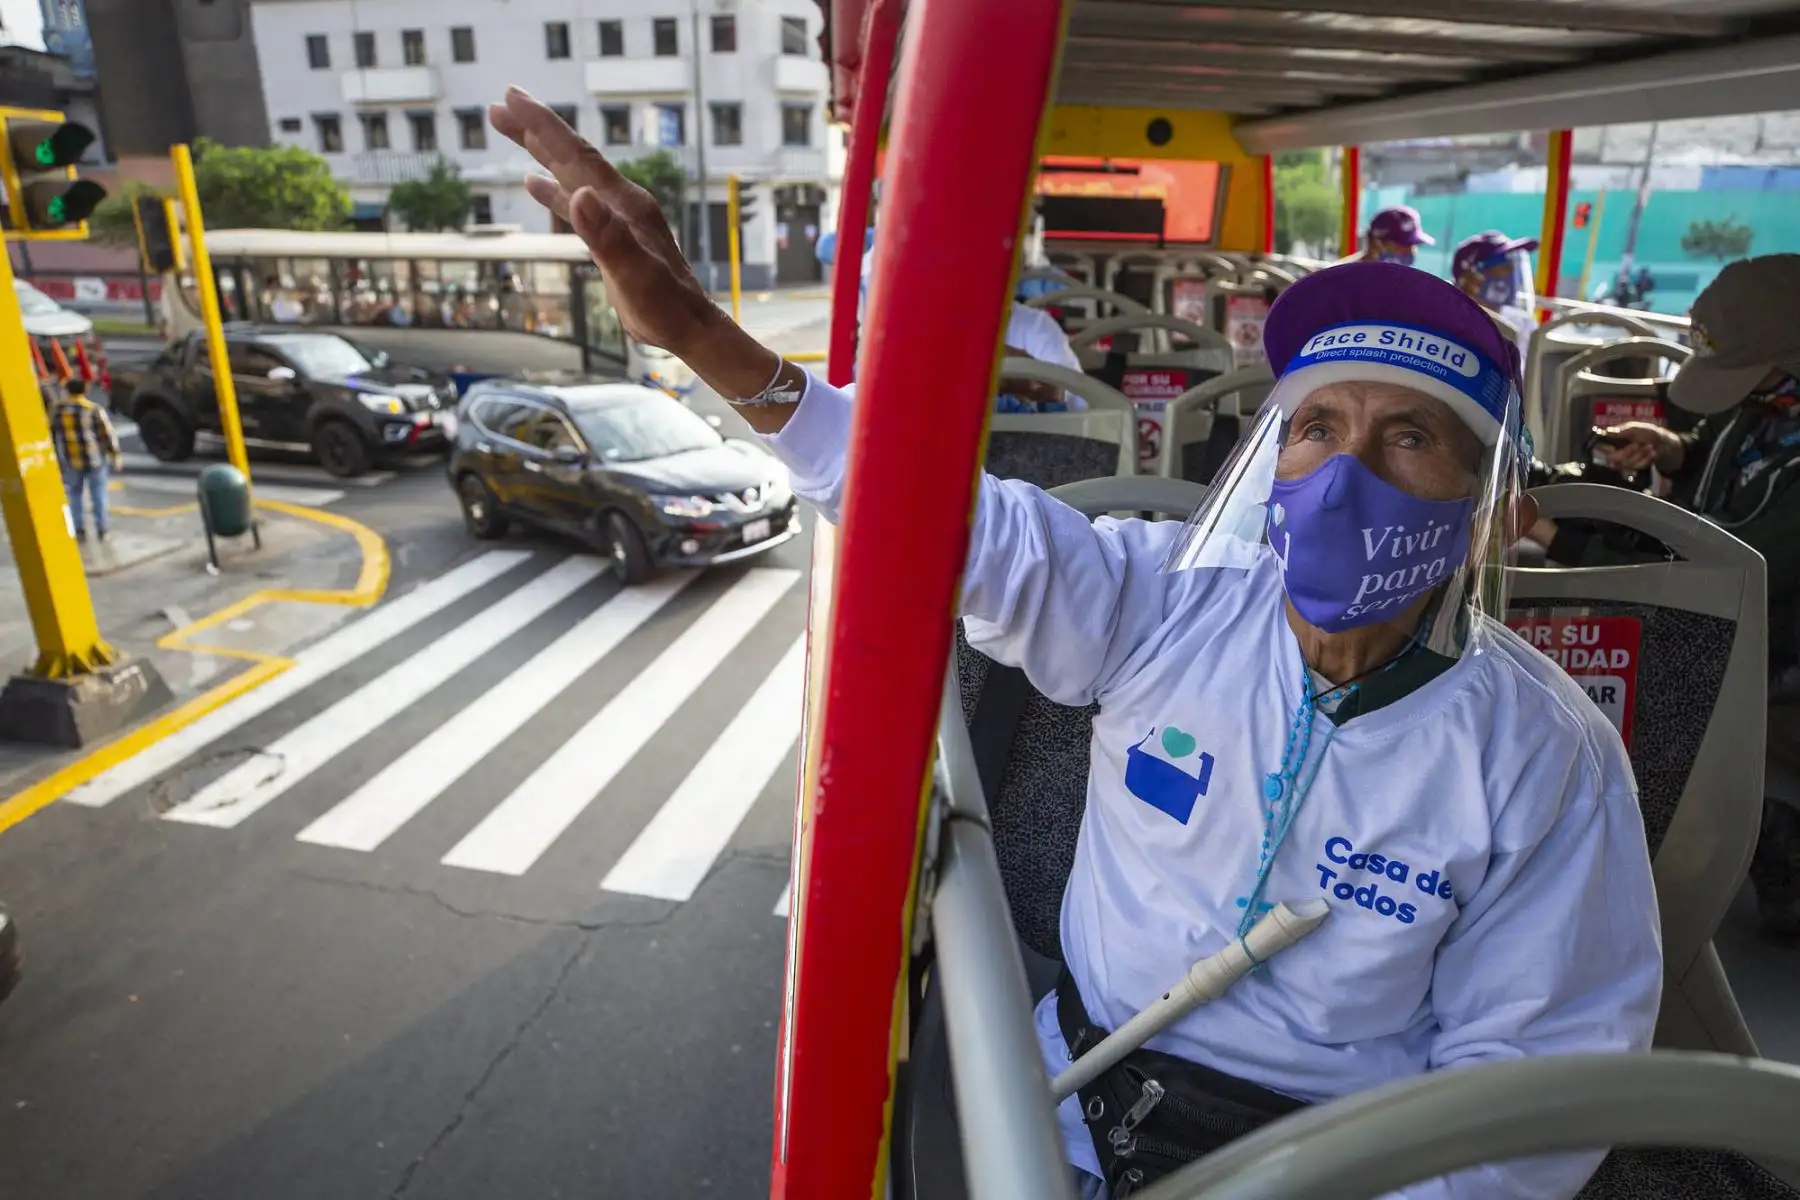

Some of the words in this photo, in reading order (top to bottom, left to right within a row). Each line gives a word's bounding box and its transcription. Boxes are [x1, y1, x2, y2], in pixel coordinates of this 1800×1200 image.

[1310, 331, 1367, 351] Face
[1378, 330, 1467, 369] Shield
[1315, 348, 1348, 360] Direct
[1349, 348, 1387, 359] splash
[1389, 352, 1448, 377] protection
[1361, 519, 1450, 561] Vivir
[1351, 556, 1446, 605] para
[1515, 625, 1552, 646] OR
[1561, 624, 1601, 646] SU
[1542, 648, 1630, 669] RIDAD
[1587, 685, 1616, 705] AR
[1324, 836, 1410, 884] Casa
[1416, 869, 1453, 900] de
[1316, 863, 1417, 924] Todos
